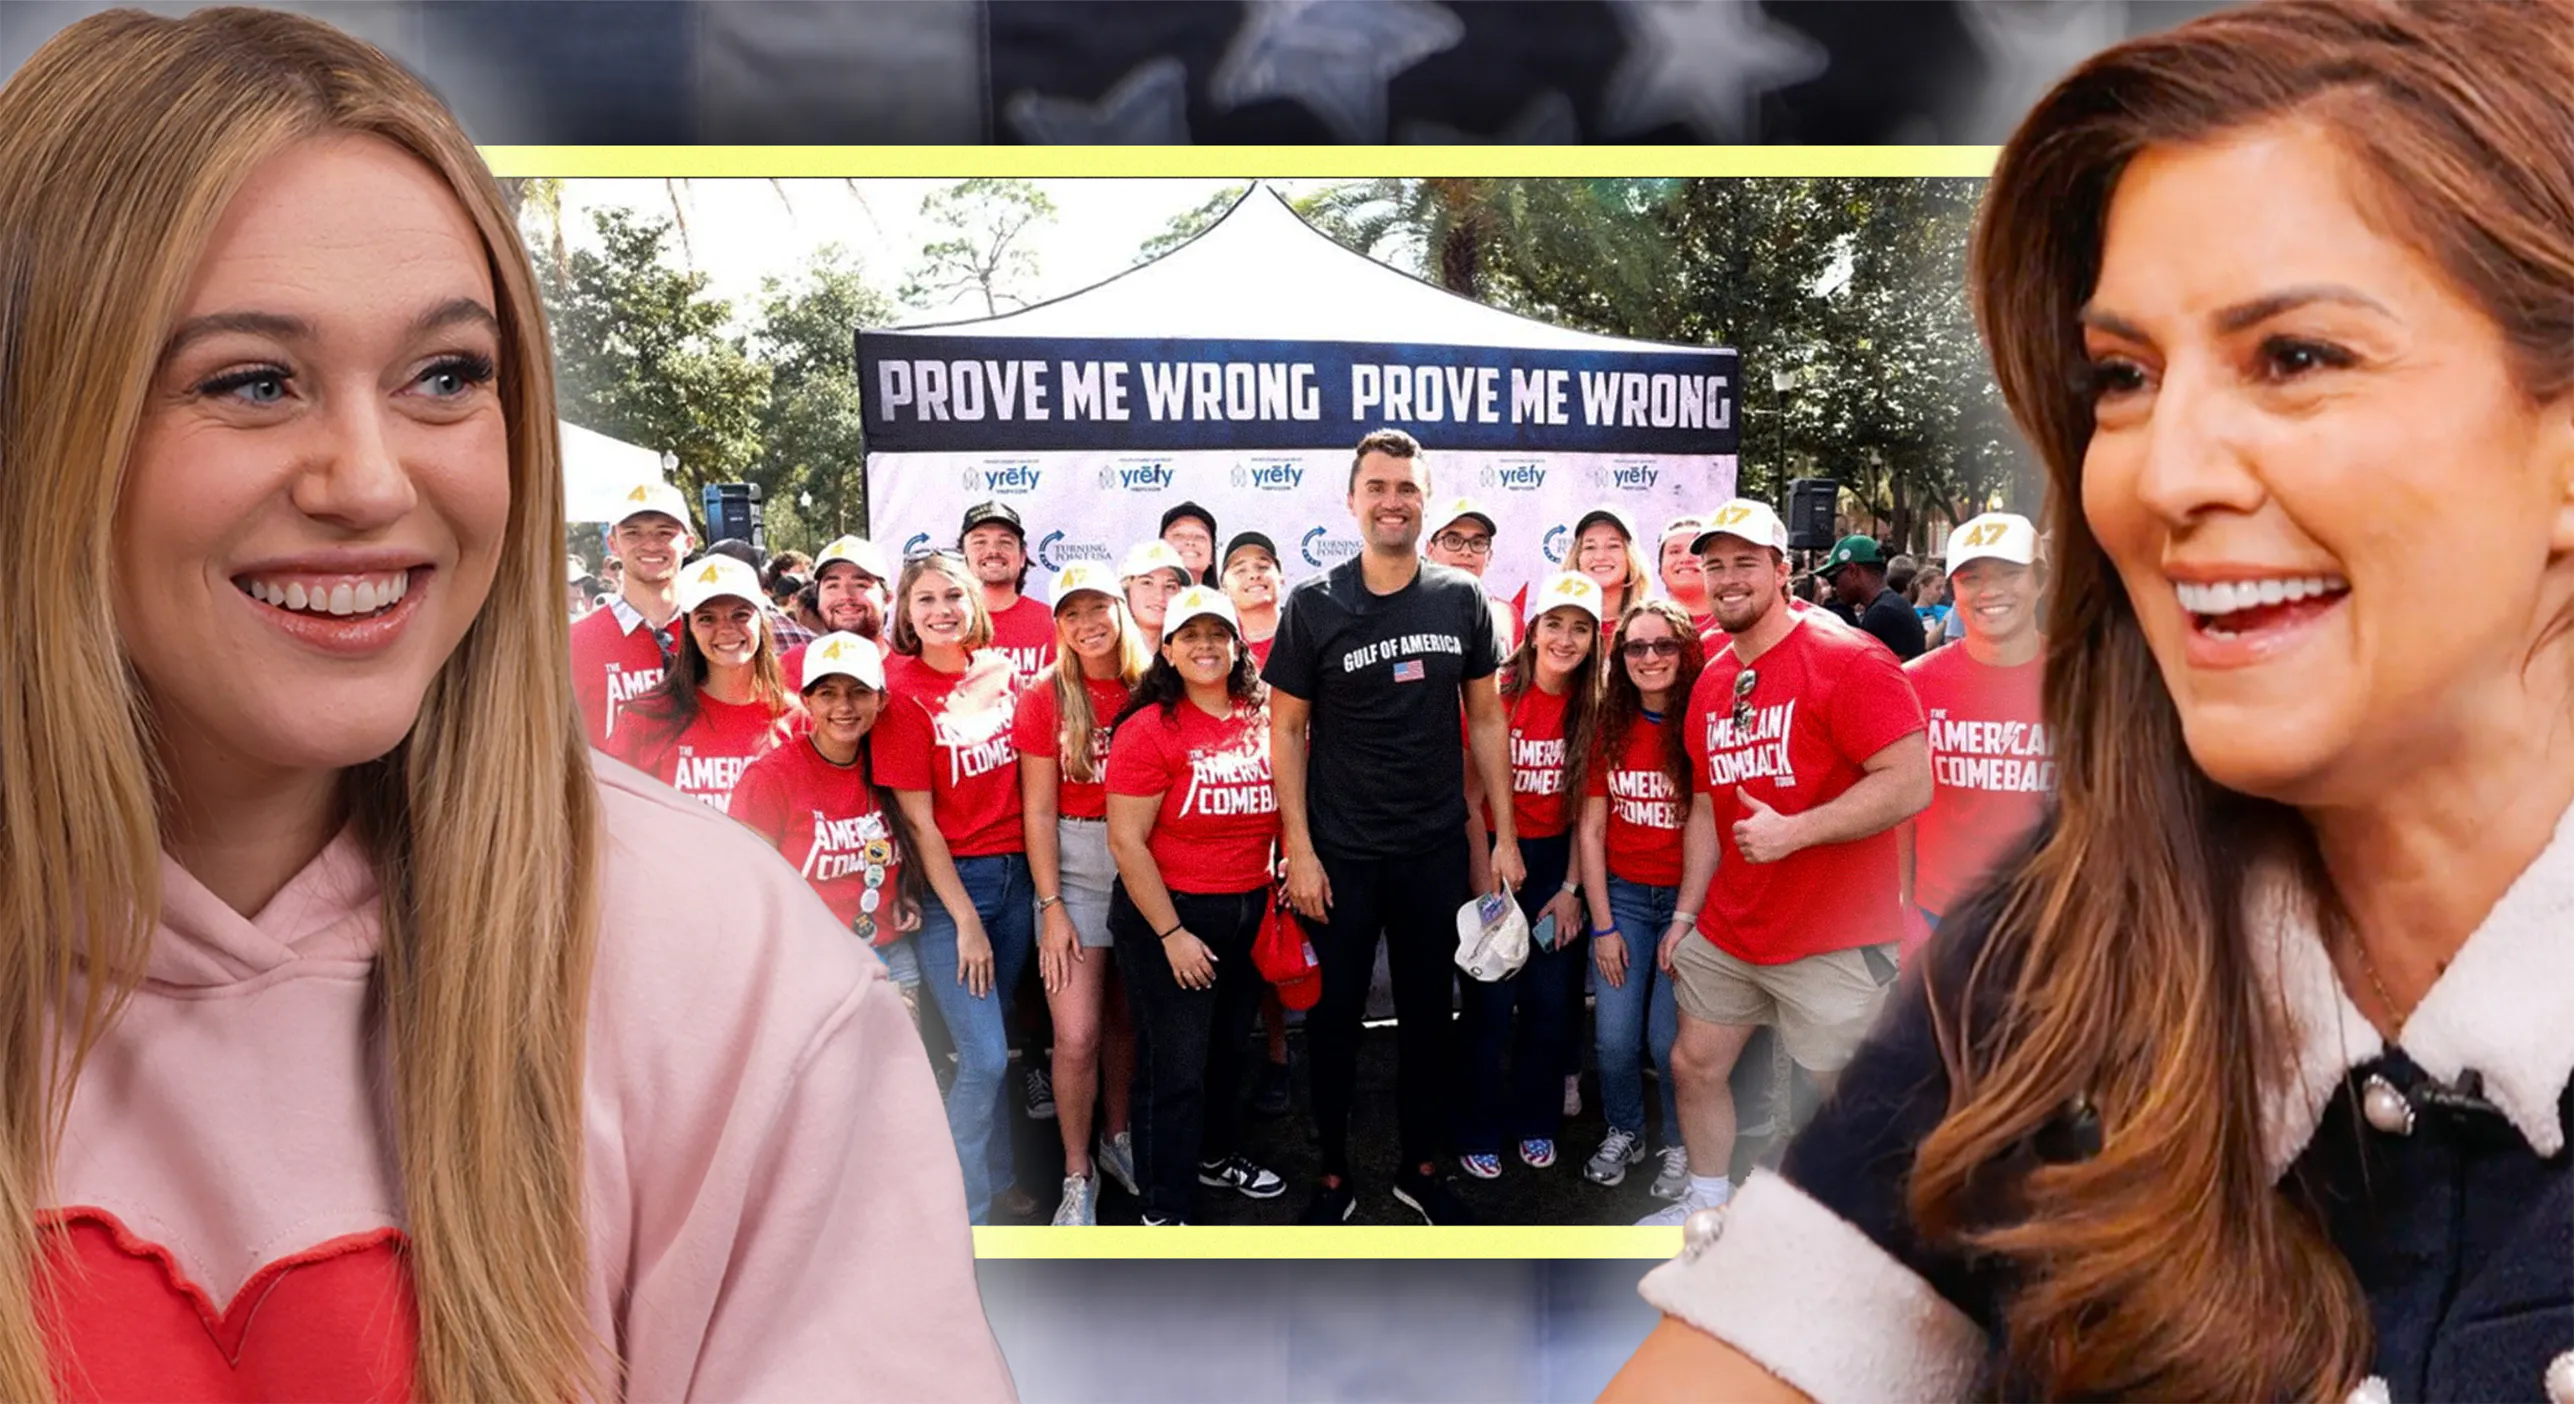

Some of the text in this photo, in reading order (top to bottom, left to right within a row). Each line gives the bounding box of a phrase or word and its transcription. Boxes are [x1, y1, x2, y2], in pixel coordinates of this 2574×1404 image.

[878, 360, 1320, 421] PROVE ME WRONG
[1351, 364, 1731, 429] PROVE ME WRONG
[1713, 507, 1751, 526] 47
[1963, 523, 2008, 547] 47
[1555, 579, 1591, 595] 47
[1343, 634, 1462, 673] GULF OF AMERICA
[1199, 785, 1278, 815] COMEB
